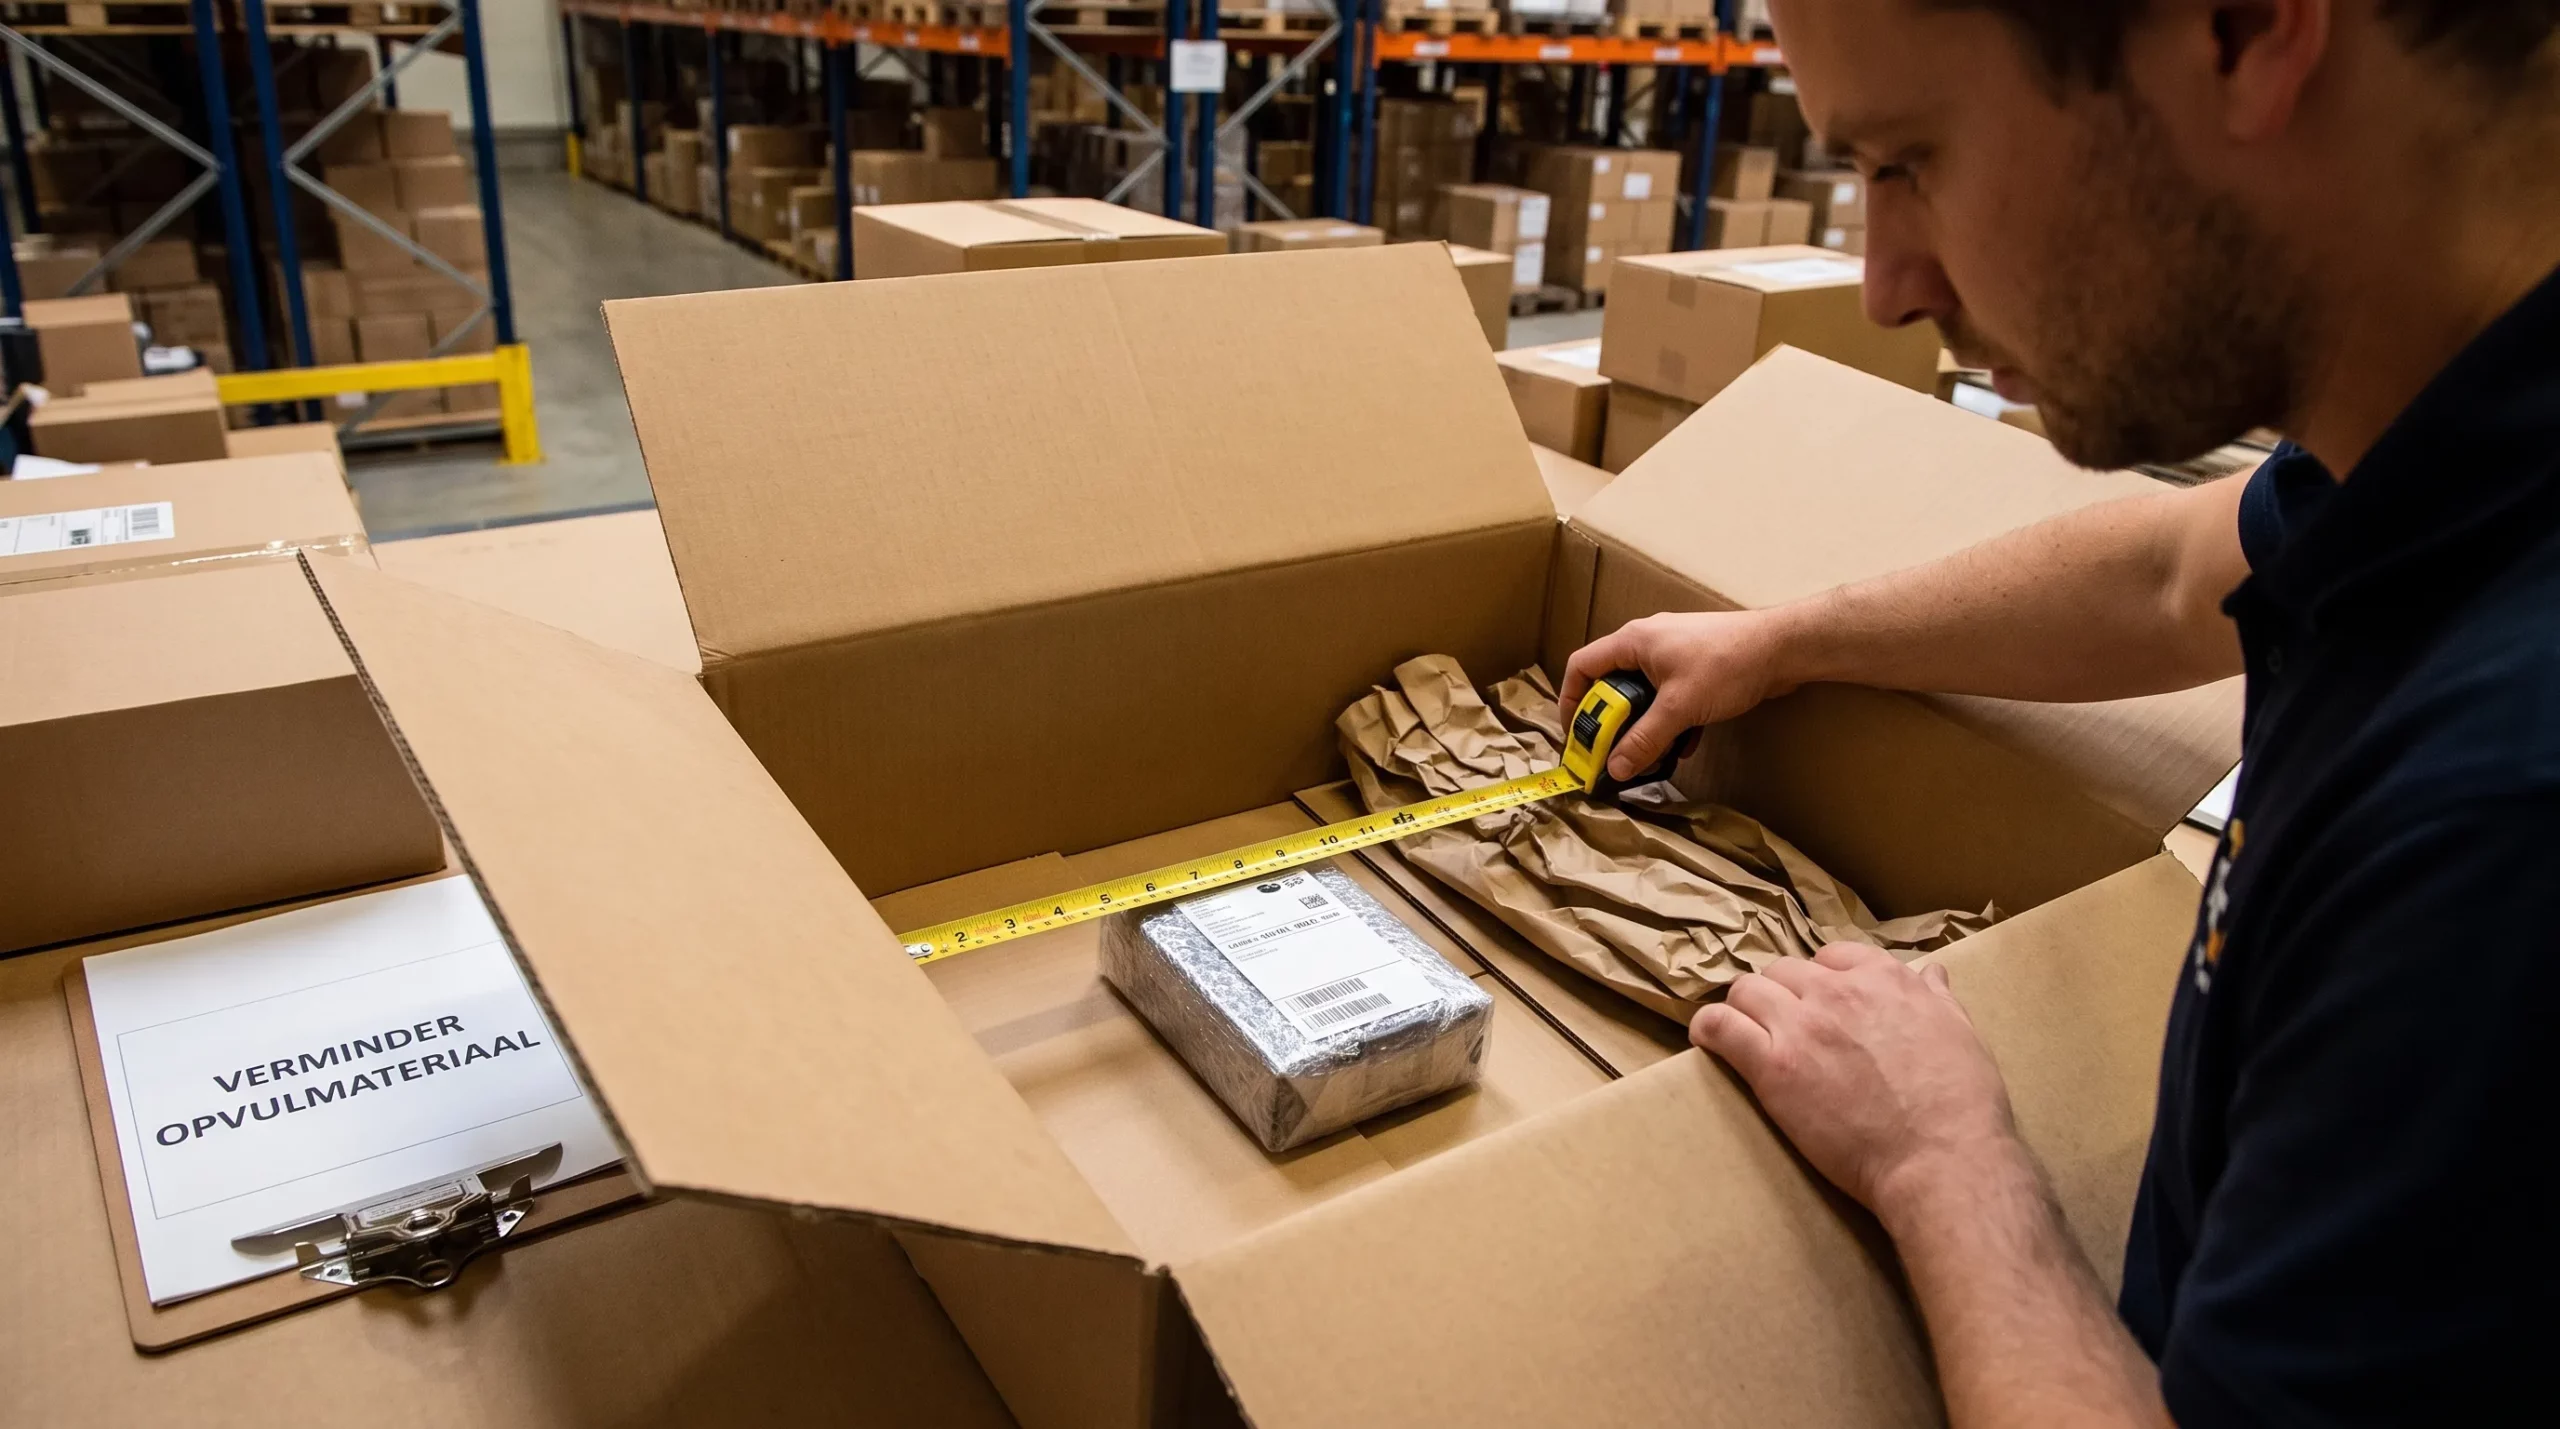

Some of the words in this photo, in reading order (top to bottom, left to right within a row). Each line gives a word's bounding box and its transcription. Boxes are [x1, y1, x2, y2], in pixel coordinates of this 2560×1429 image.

[954, 931, 967, 943] 2
[1004, 918, 1016, 929] 3
[1053, 906, 1064, 916] 4
[1099, 893, 1111, 904] 5
[1145, 882, 1156, 892] 6
[1189, 871, 1198, 881] 7
[1319, 835, 1339, 846] 10
[1358, 825, 1375, 835] 11
[156, 1030, 541, 1146] OPVULMATERIAAL
[213, 1015, 465, 1093] VERMINDER
